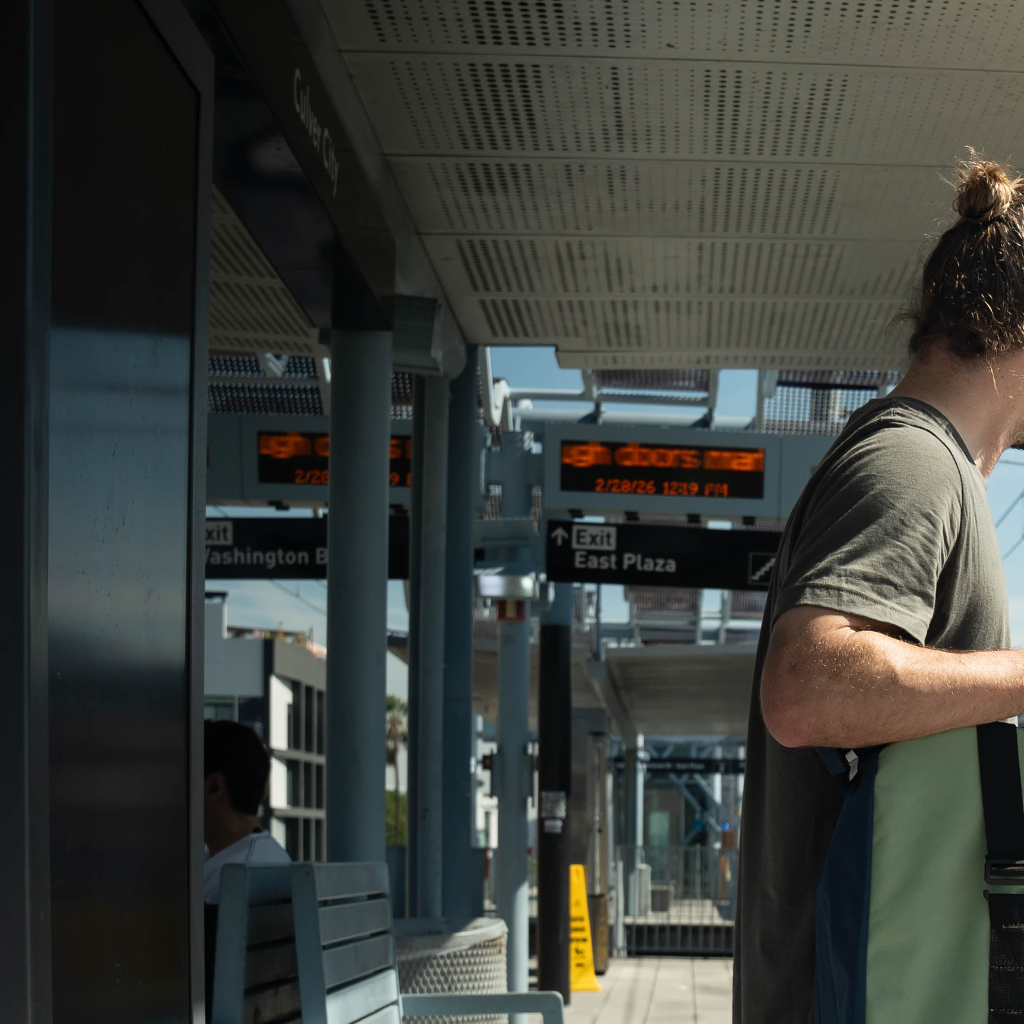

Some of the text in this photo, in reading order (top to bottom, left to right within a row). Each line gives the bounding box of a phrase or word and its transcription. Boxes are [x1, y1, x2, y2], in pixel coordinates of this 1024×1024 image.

[294, 67, 339, 197] Culver City
[595, 478, 656, 495] 2/28/26
[206, 524, 230, 542] xit
[576, 528, 613, 547] Exit
[574, 550, 677, 573] East Plaza
